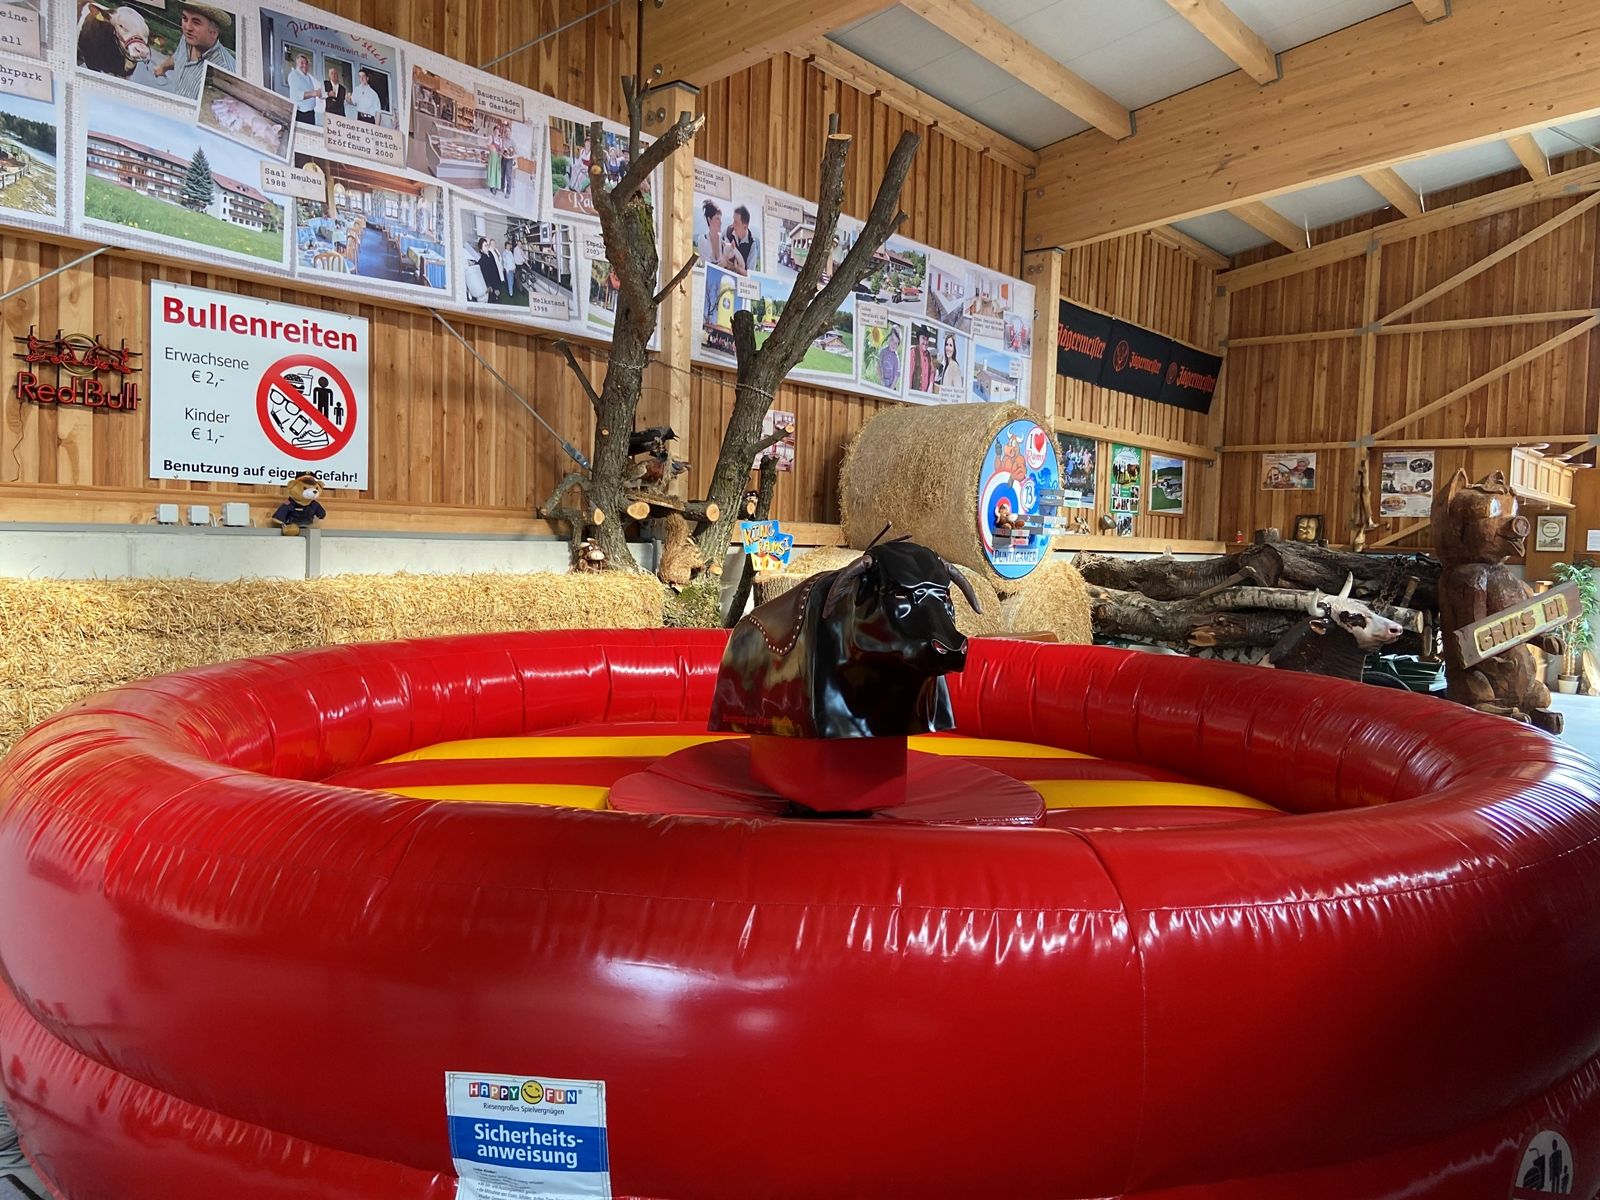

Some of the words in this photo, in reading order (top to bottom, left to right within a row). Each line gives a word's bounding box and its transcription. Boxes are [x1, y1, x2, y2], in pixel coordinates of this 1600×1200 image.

[477, 89, 521, 108] Bauernladen
[478, 98, 487, 106] im
[489, 101, 516, 115] Gasthof
[327, 127, 341, 137] bei
[346, 132, 361, 142] der
[336, 120, 393, 141] Generationen
[327, 137, 371, 155] Eröffnung
[375, 148, 394, 159] 2000
[264, 167, 286, 178] Saal
[290, 173, 322, 186] Neubau
[265, 178, 287, 188] 1988
[532, 297, 566, 307] Melkstand
[163, 296, 358, 352] Bullenreiten
[165, 347, 249, 370] Erwachsene
[191, 370, 201, 383] €
[206, 371, 225, 388] 2,-
[16, 371, 77, 404] Red
[84, 378, 138, 411] Bull
[184, 407, 230, 424] Kinder
[191, 427, 201, 441] €
[206, 429, 225, 445] 1,-
[163, 459, 239, 478] Benutzung
[243, 465, 265, 477] auf
[315, 470, 358, 484] Gefahr!
[469, 1082, 520, 1100] HAPPY
[545, 1088, 577, 1104] FUN
[483, 1103, 520, 1112] Riesengroßes
[520, 1106, 565, 1115] Spielvergnügen
[474, 1123, 583, 1148] Sicherheits-
[477, 1144, 578, 1168] anweisung
